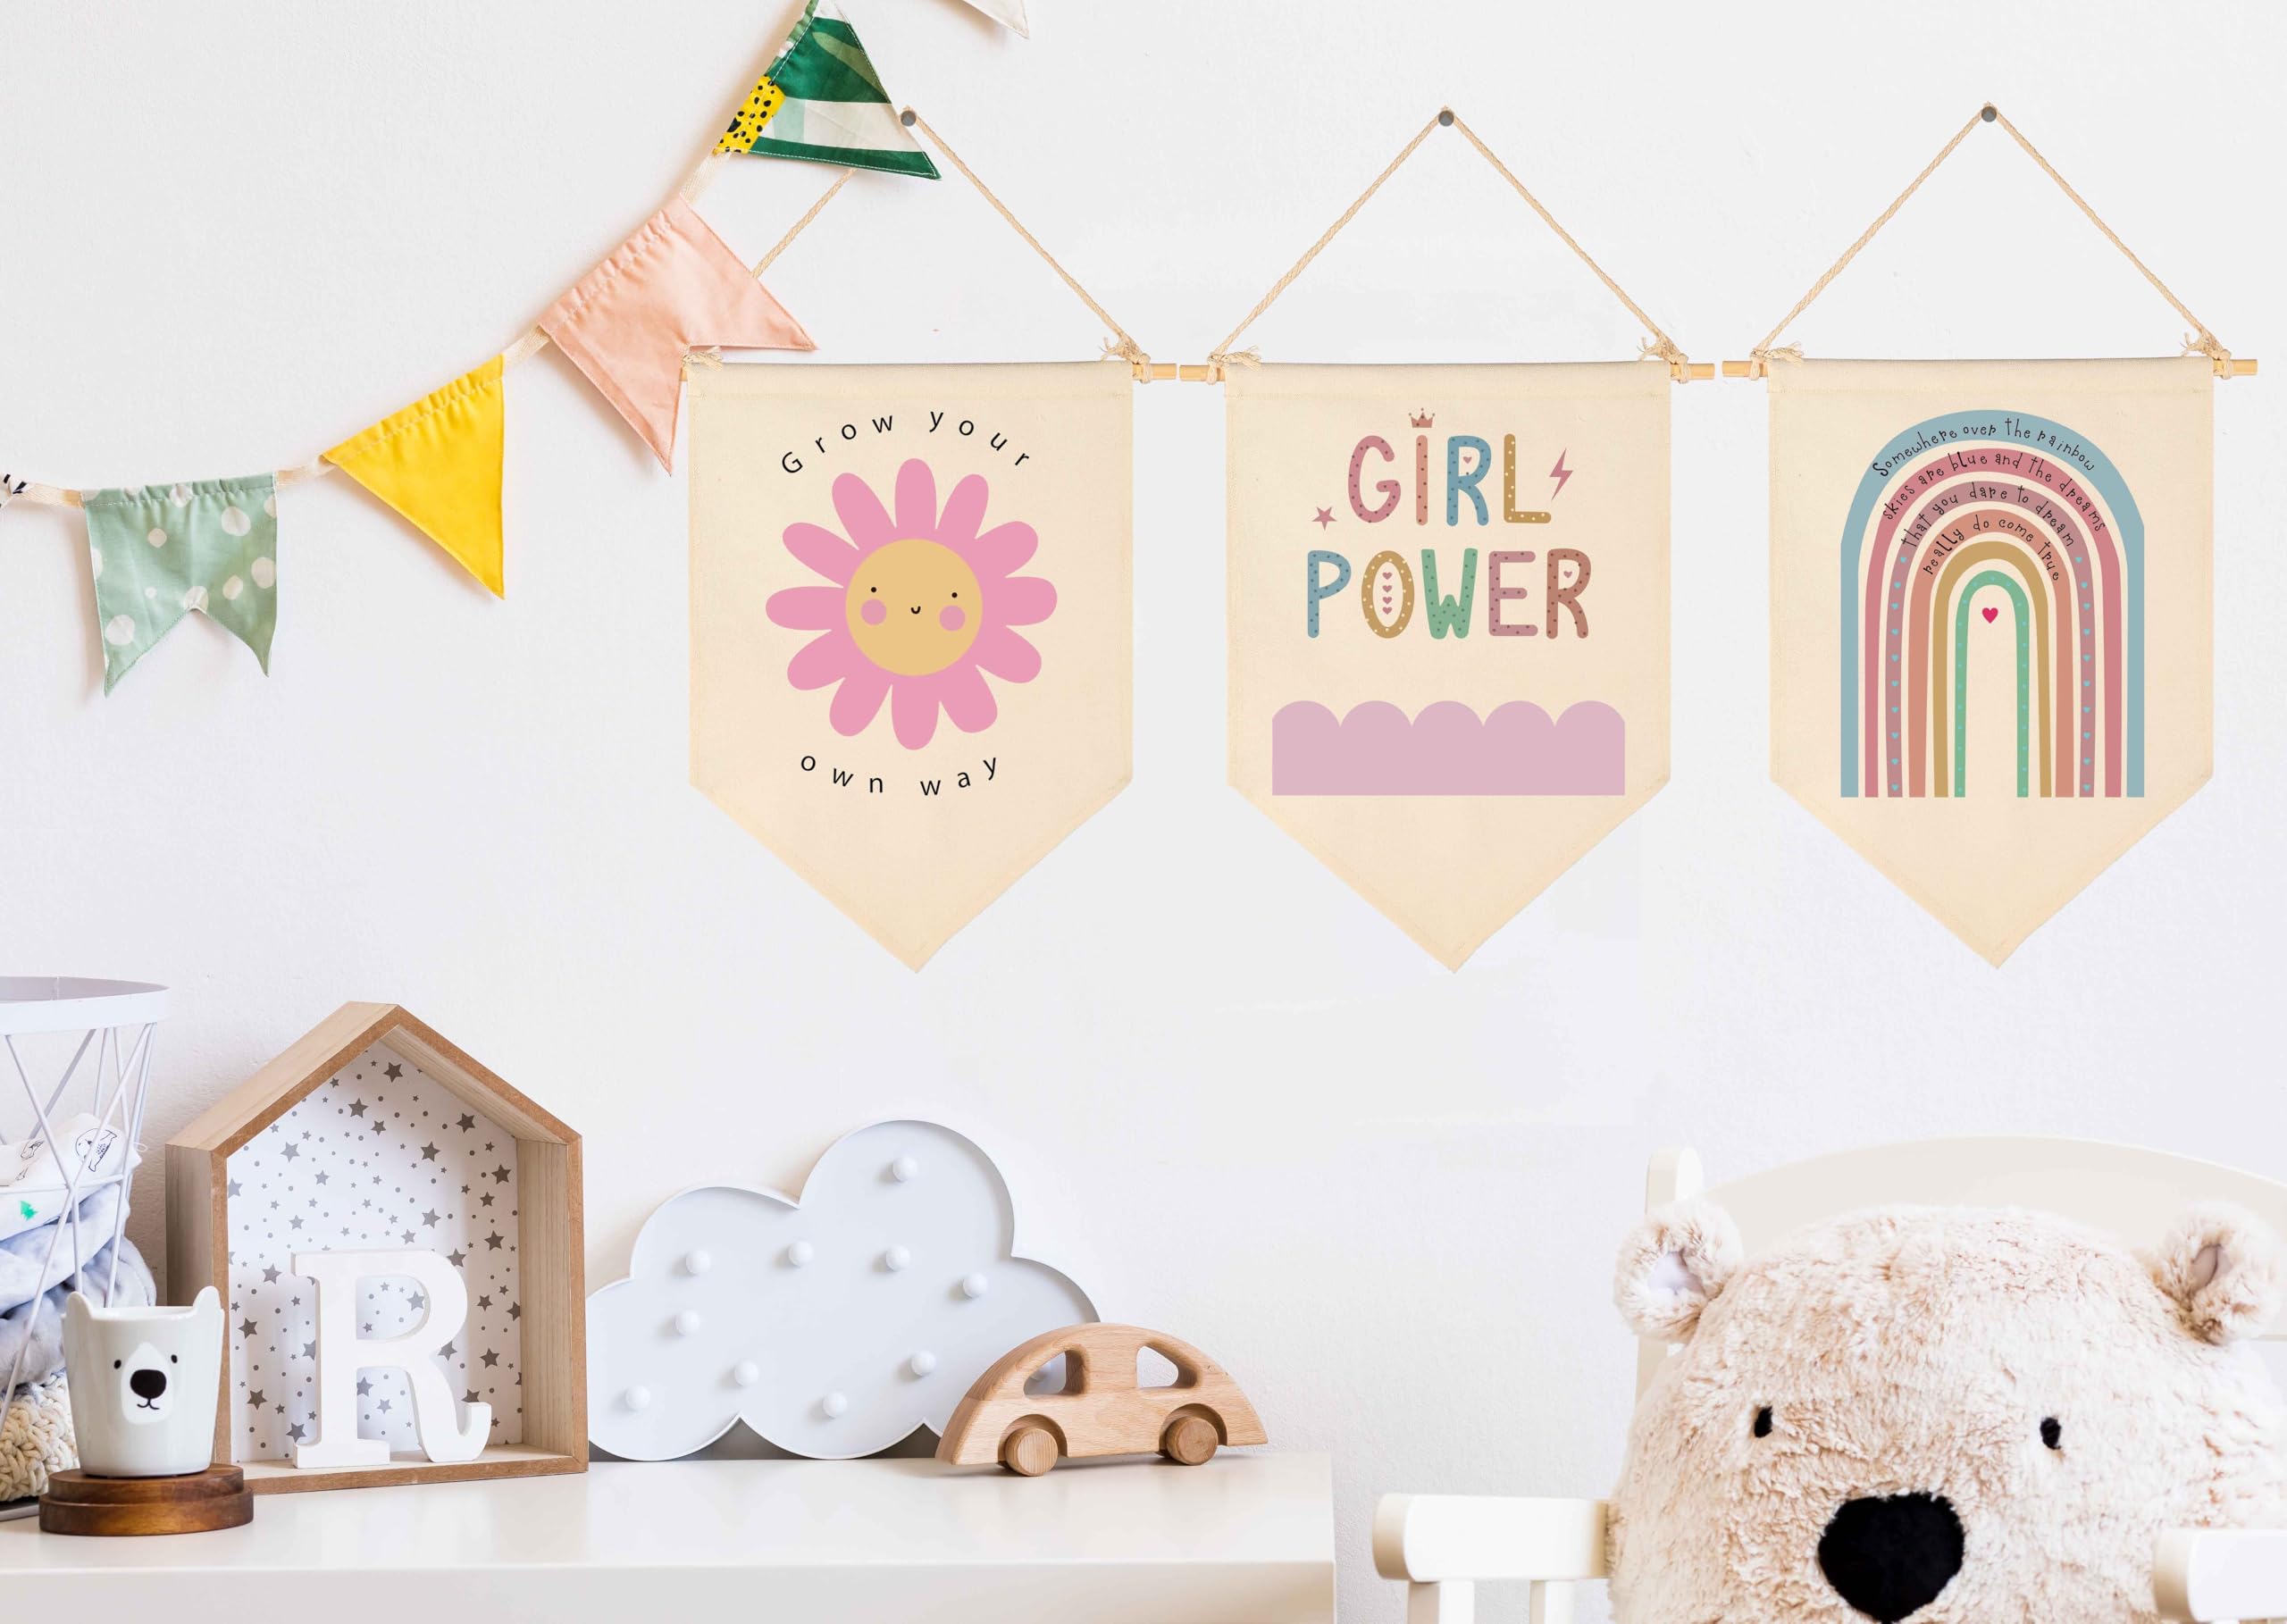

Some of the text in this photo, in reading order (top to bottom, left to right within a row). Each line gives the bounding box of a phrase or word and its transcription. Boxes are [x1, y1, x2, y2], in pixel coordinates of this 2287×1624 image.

[782, 411, 1029, 473] Grow your
[1872, 417, 2095, 477] Somewhere over the rainbow
[1348, 433, 1552, 526] GIRL
[1882, 451, 2107, 532] skies are blue and the dreams
[1900, 482, 2073, 548] that you dare to dream
[1923, 514, 2059, 581] really do come true
[1307, 548, 1592, 640] POWER
[800, 755, 997, 796] own way
[293, 1250, 491, 1468] R
